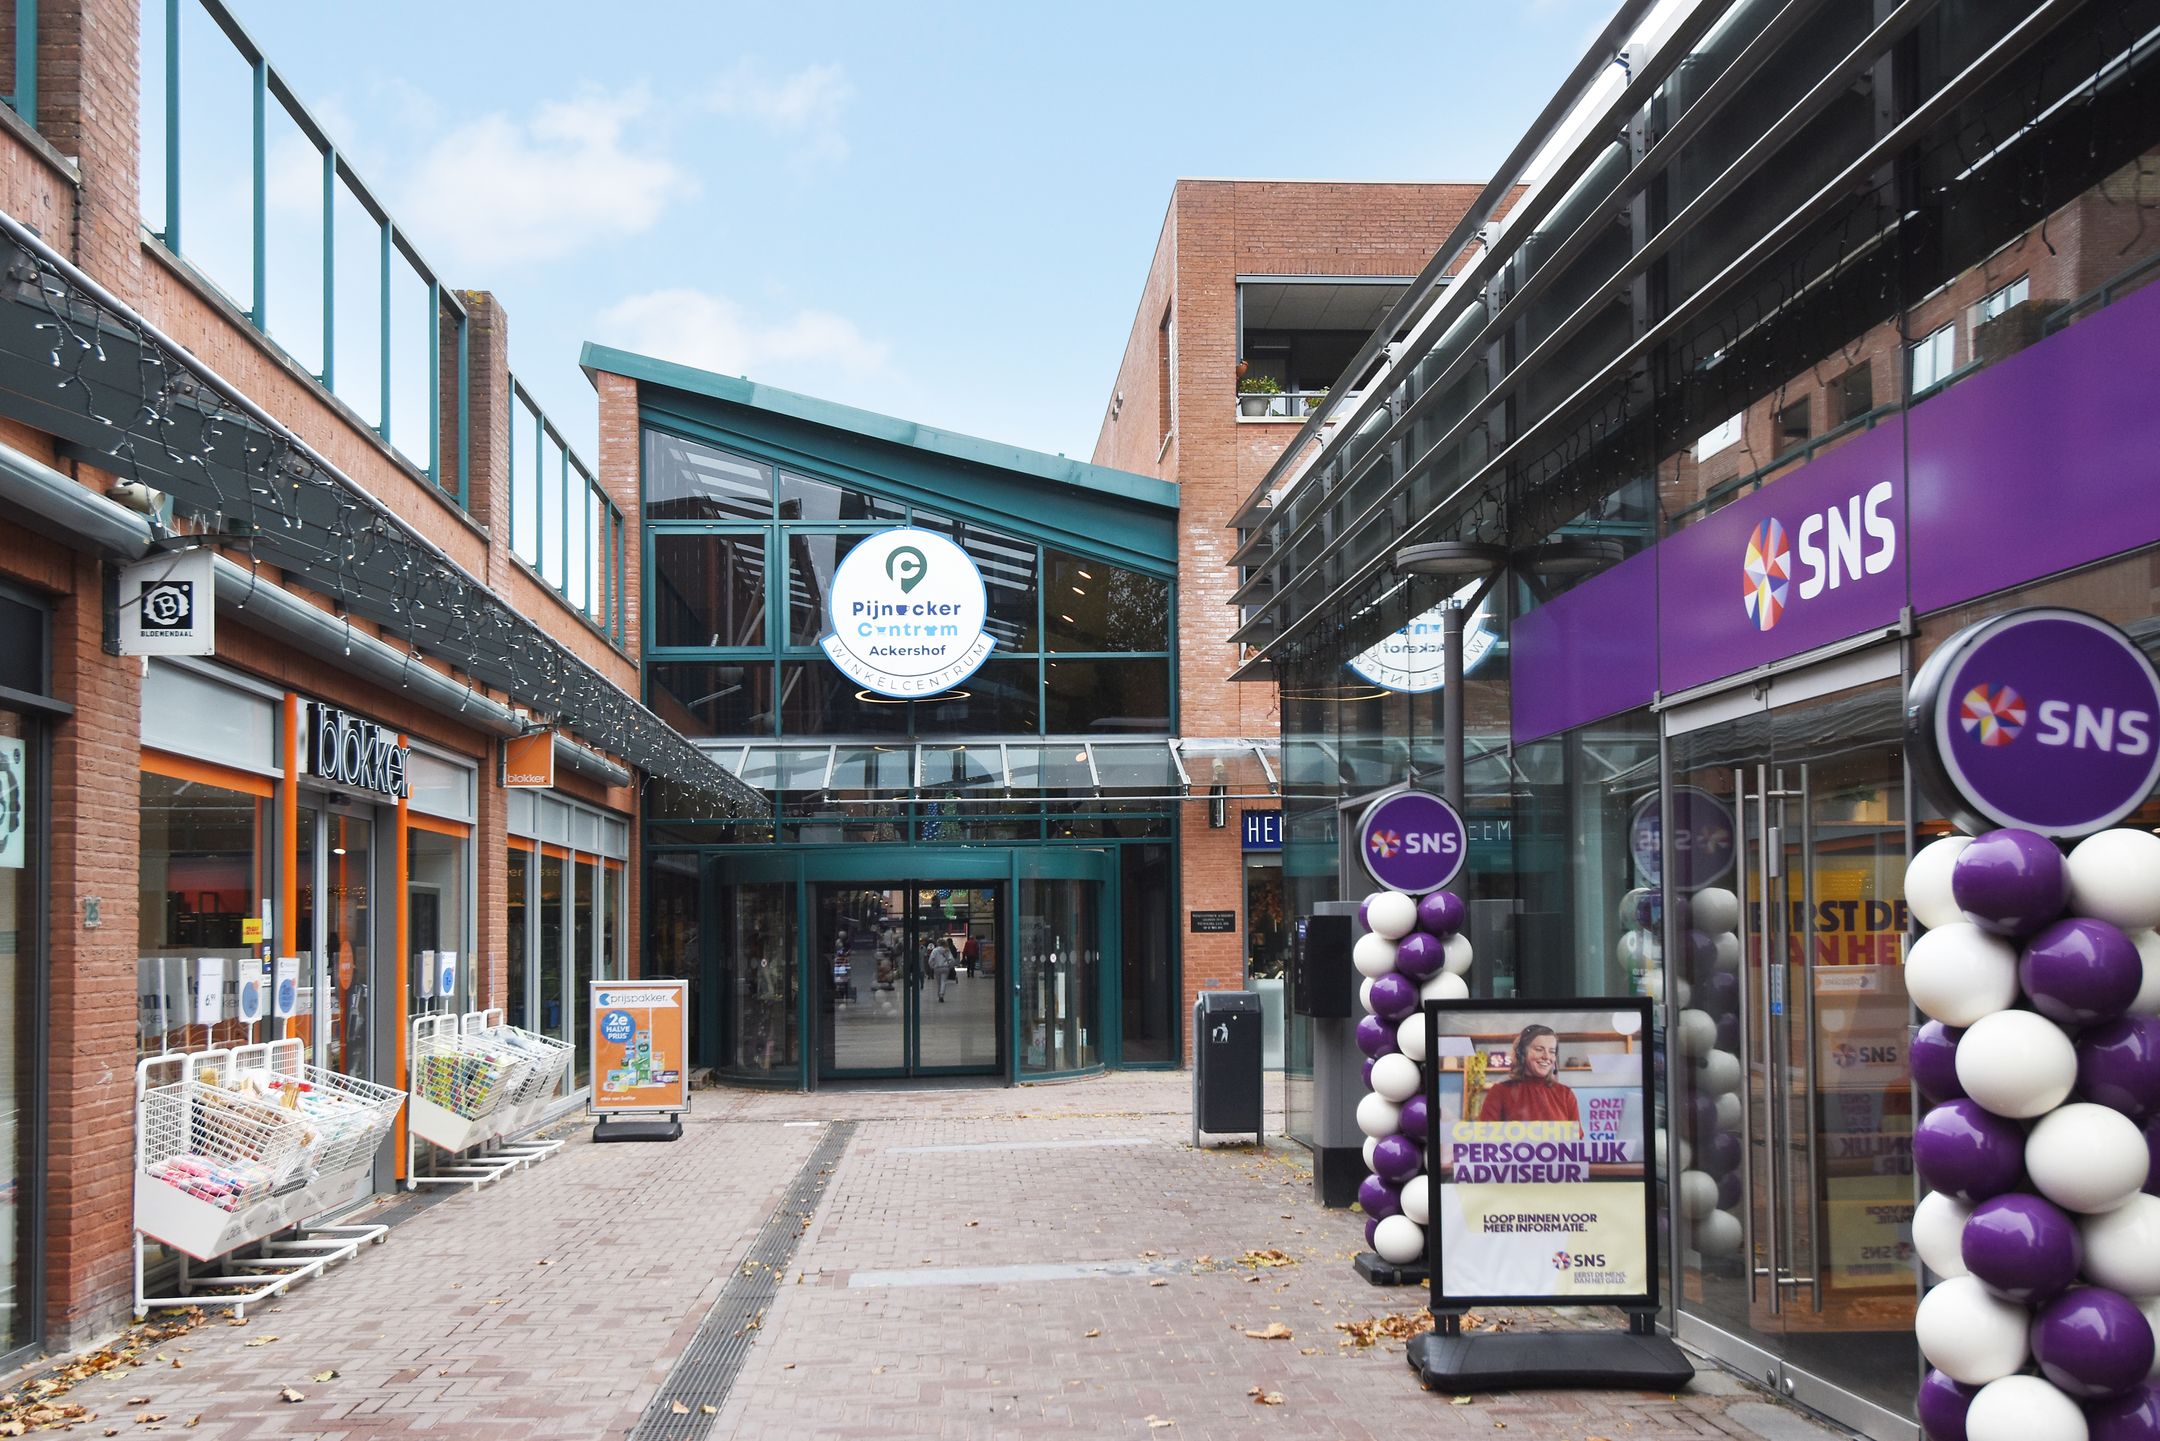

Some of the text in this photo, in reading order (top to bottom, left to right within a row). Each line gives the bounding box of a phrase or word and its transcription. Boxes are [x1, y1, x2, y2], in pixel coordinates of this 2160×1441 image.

[1799, 481, 1895, 600] SNS
[869, 645, 946, 656] Ackershof
[832, 643, 986, 691] WINKELCENTRUM
[2036, 700, 2149, 756] SNS
[1405, 832, 1457, 854] SNS
[1866, 901, 1908, 932] DE
[1847, 934, 1903, 965] HE
[609, 1014, 628, 1026] 2e
[1859, 1047, 1897, 1062] SNS
[1452, 1121, 1580, 1142] GEZOCHT:
[1589, 1121, 1601, 1132] IS
[1453, 1142, 1628, 1163] PERSOONLIJK
[1483, 1213, 1597, 1223] LOOP BINNEN VOOR
[1483, 1223, 1587, 1233] MEER INFORMATIE.
[1574, 1254, 1606, 1267] SNS
